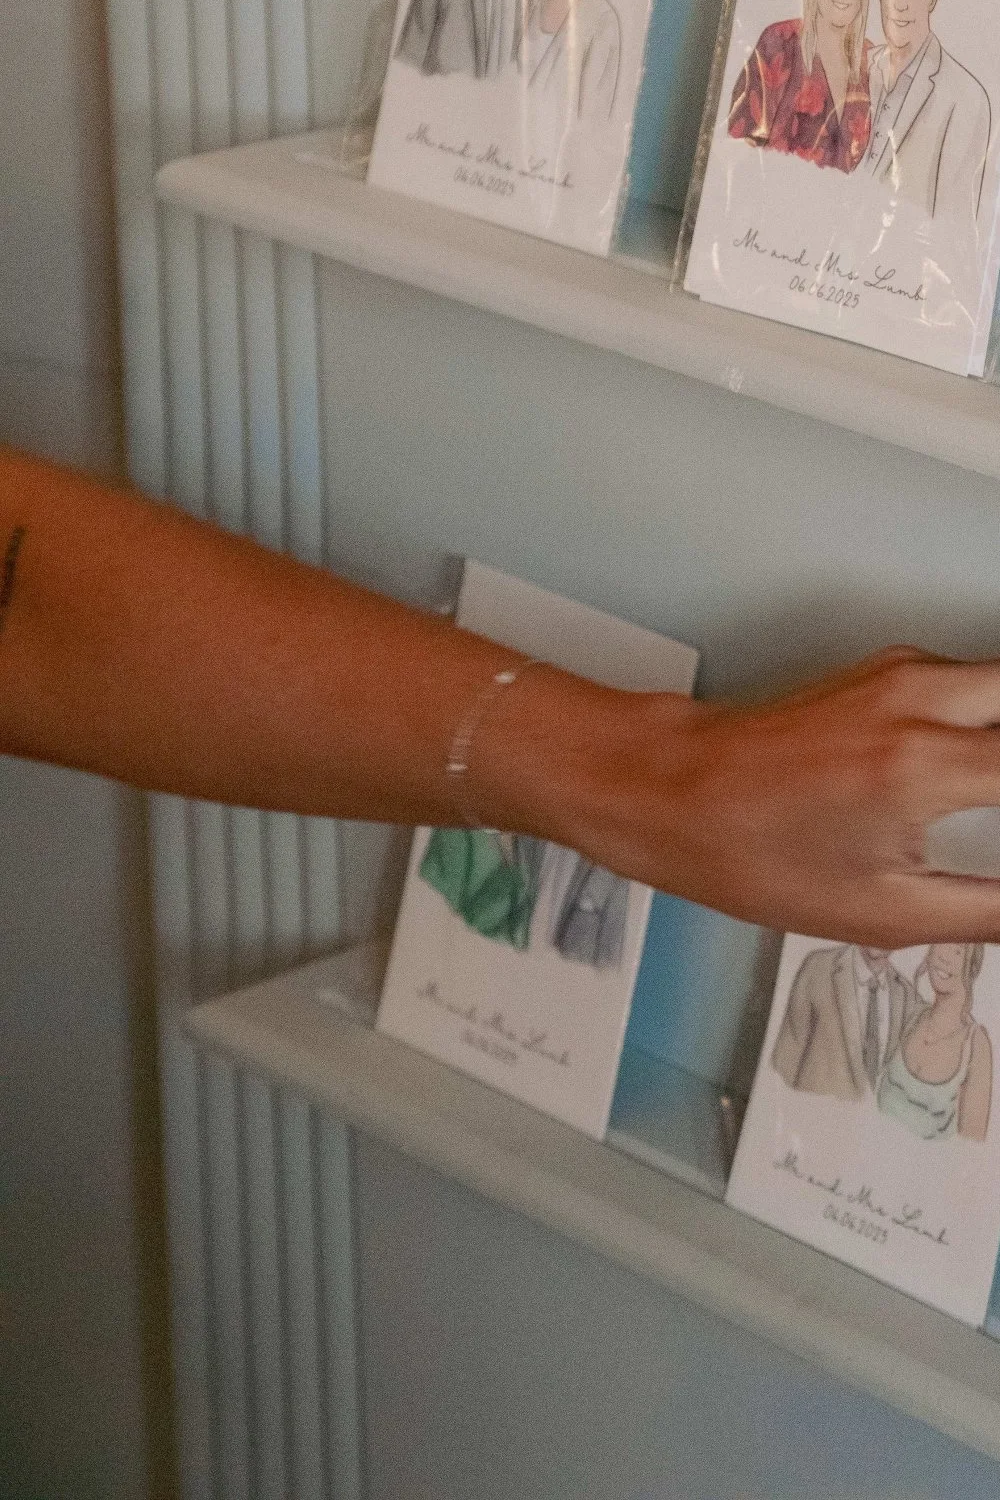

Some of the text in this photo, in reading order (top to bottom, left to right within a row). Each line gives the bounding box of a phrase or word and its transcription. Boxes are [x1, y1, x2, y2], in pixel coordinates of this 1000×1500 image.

[733, 227, 767, 255] Mr
[770, 247, 810, 267] and
[815, 251, 860, 282] Mrs
